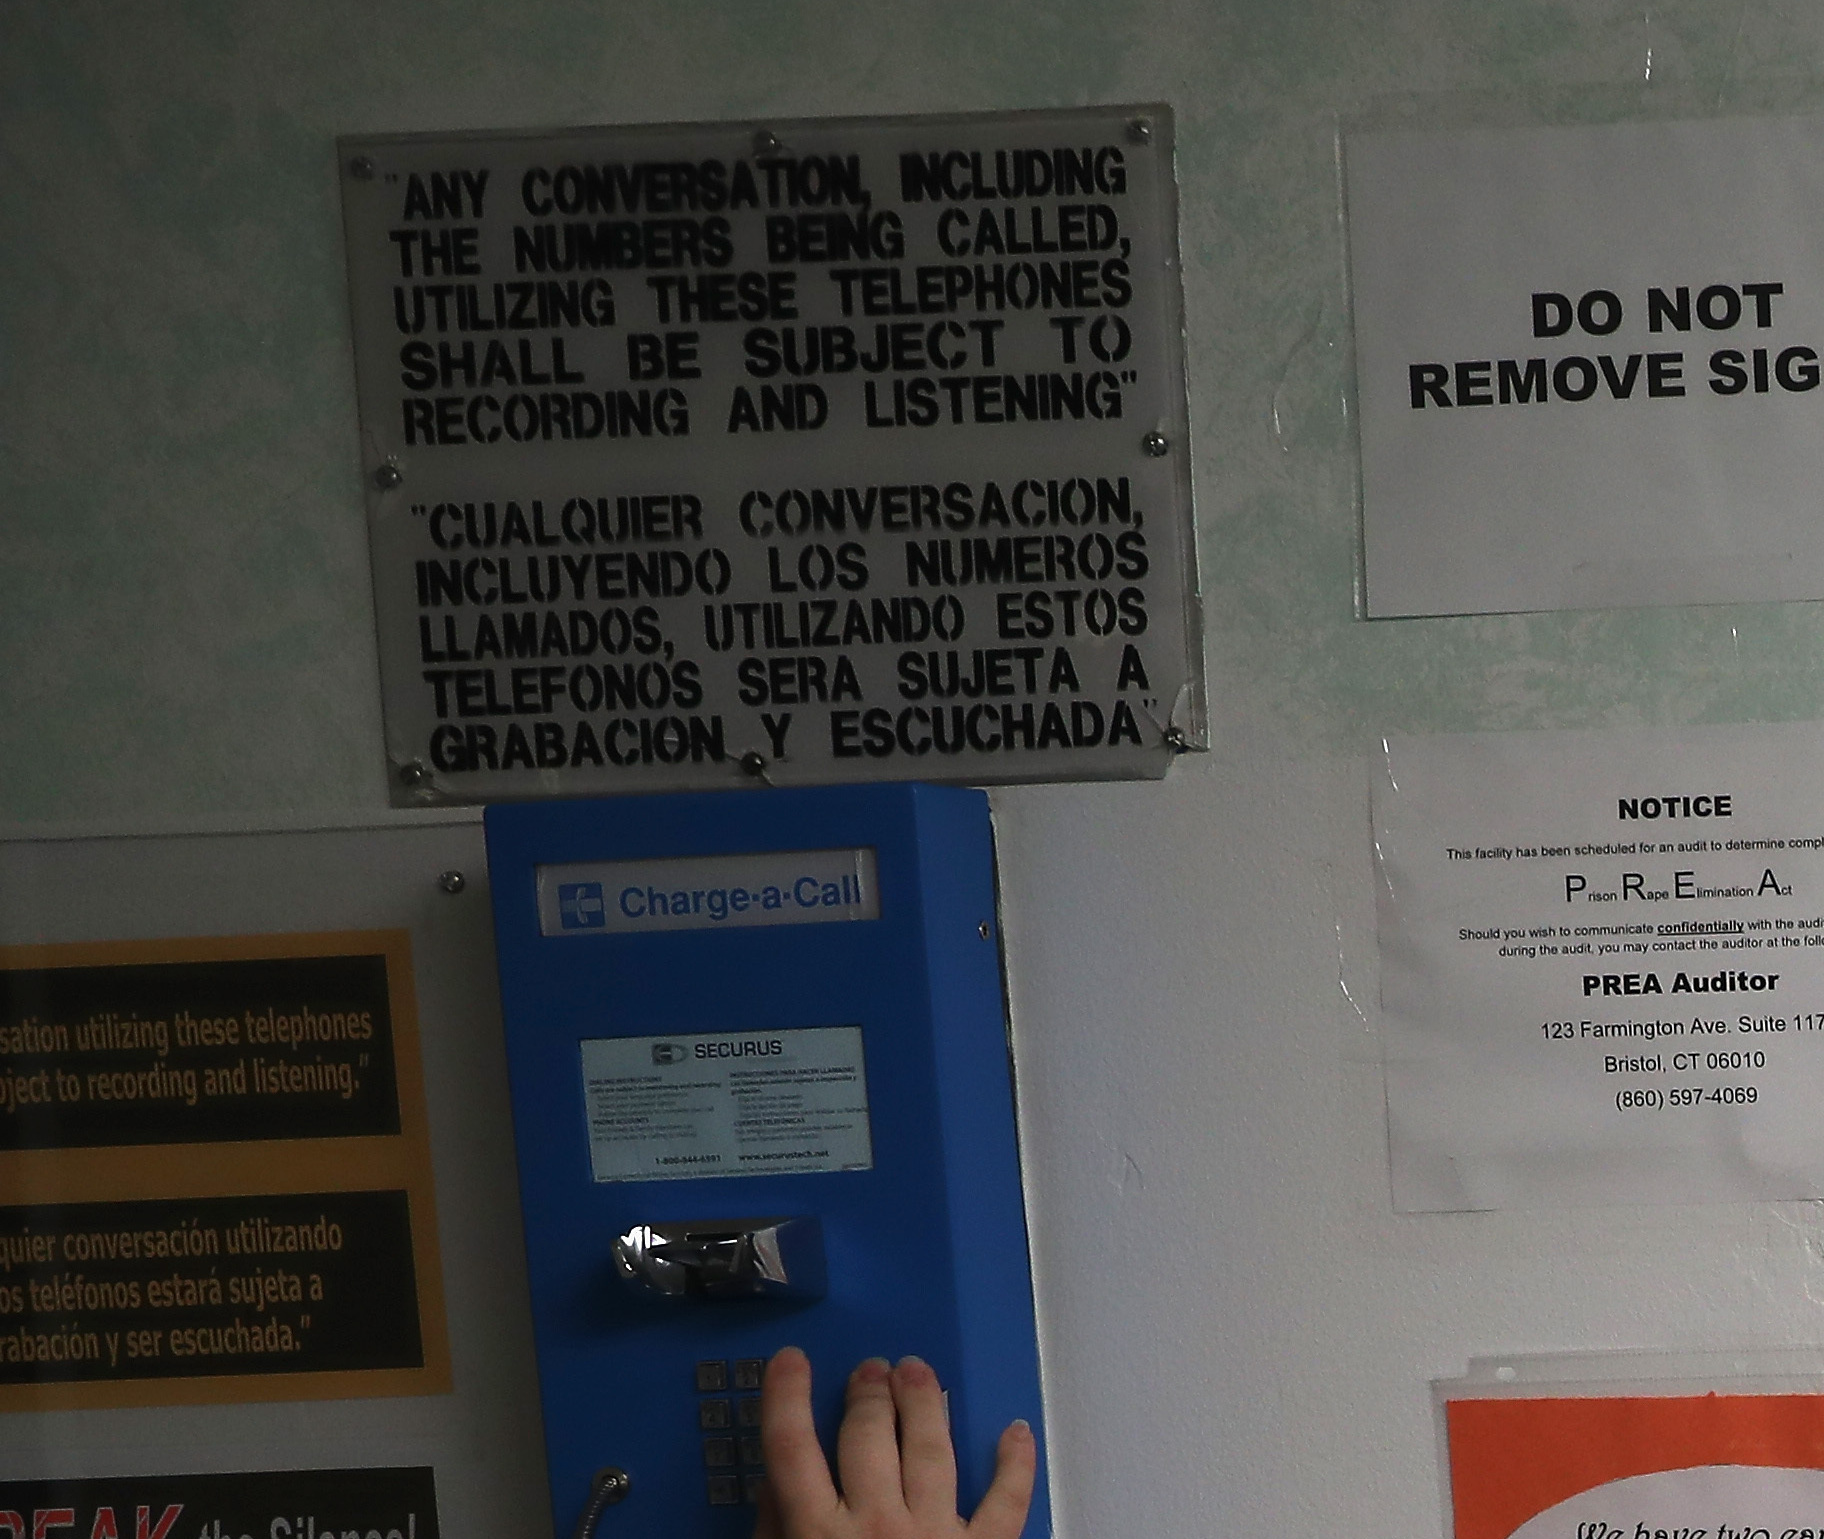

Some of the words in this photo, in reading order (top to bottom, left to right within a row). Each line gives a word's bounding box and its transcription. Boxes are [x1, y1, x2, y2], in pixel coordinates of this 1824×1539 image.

[522, 155, 871, 216] CONVERSATION,
[900, 147, 1126, 202] INCLUDING
[389, 228, 481, 277] THE
[514, 216, 734, 273] NUMBERS
[766, 210, 904, 264] BEING
[938, 204, 1130, 258] CALLED,
[394, 278, 615, 334] UTILIZING
[646, 271, 798, 324] THESE
[829, 258, 1132, 317] TELEPHONES
[1532, 290, 1622, 337] DO
[1648, 283, 1783, 332] NOT
[400, 337, 584, 391] SHALL
[627, 332, 701, 381] BE
[744, 319, 1004, 378] SUBJECT
[1050, 315, 1131, 364] TO
[1409, 353, 1685, 409] REMOVE
[403, 388, 689, 445] RECORDING
[728, 383, 828, 433] AND
[865, 370, 1136, 427] LISTENING"
[1618, 795, 1732, 820] NOTICE
[1446, 848, 1472, 860] This
[1475, 847, 1513, 861] facility
[1515, 847, 1538, 858] has
[1541, 845, 1571, 857] been
[1574, 842, 1636, 856] scheduled
[1639, 841, 1656, 854] for
[1659, 843, 1674, 853] an
[1677, 840, 1707, 853] audit
[1710, 840, 1723, 852] to
[1725, 839, 1785, 851] determine
[1582, 973, 1663, 997] PREA
[1671, 970, 1780, 994] Auditor
[76, 1013, 168, 1056] utilizing
[175, 1011, 239, 1046] these
[245, 1007, 371, 1050] telephones
[694, 1039, 783, 1060] SECURUS
[1541, 1021, 1575, 1040] 123
[1580, 1019, 1685, 1040] Farmington
[1690, 1017, 1732, 1035] Ave.
[1738, 1015, 1787, 1033] Suite
[56, 1069, 80, 1101] to
[88, 1062, 197, 1105] recording
[205, 1059, 246, 1095] and
[1604, 1054, 1667, 1074] Bristol,
[1673, 1052, 1701, 1071] CT
[1706, 1051, 1766, 1070] 06010
[1615, 1089, 1664, 1112] (860)
[1669, 1086, 1758, 1106] 597-4069
[64, 1220, 218, 1260] conversación
[226, 1215, 342, 1254] utilizando
